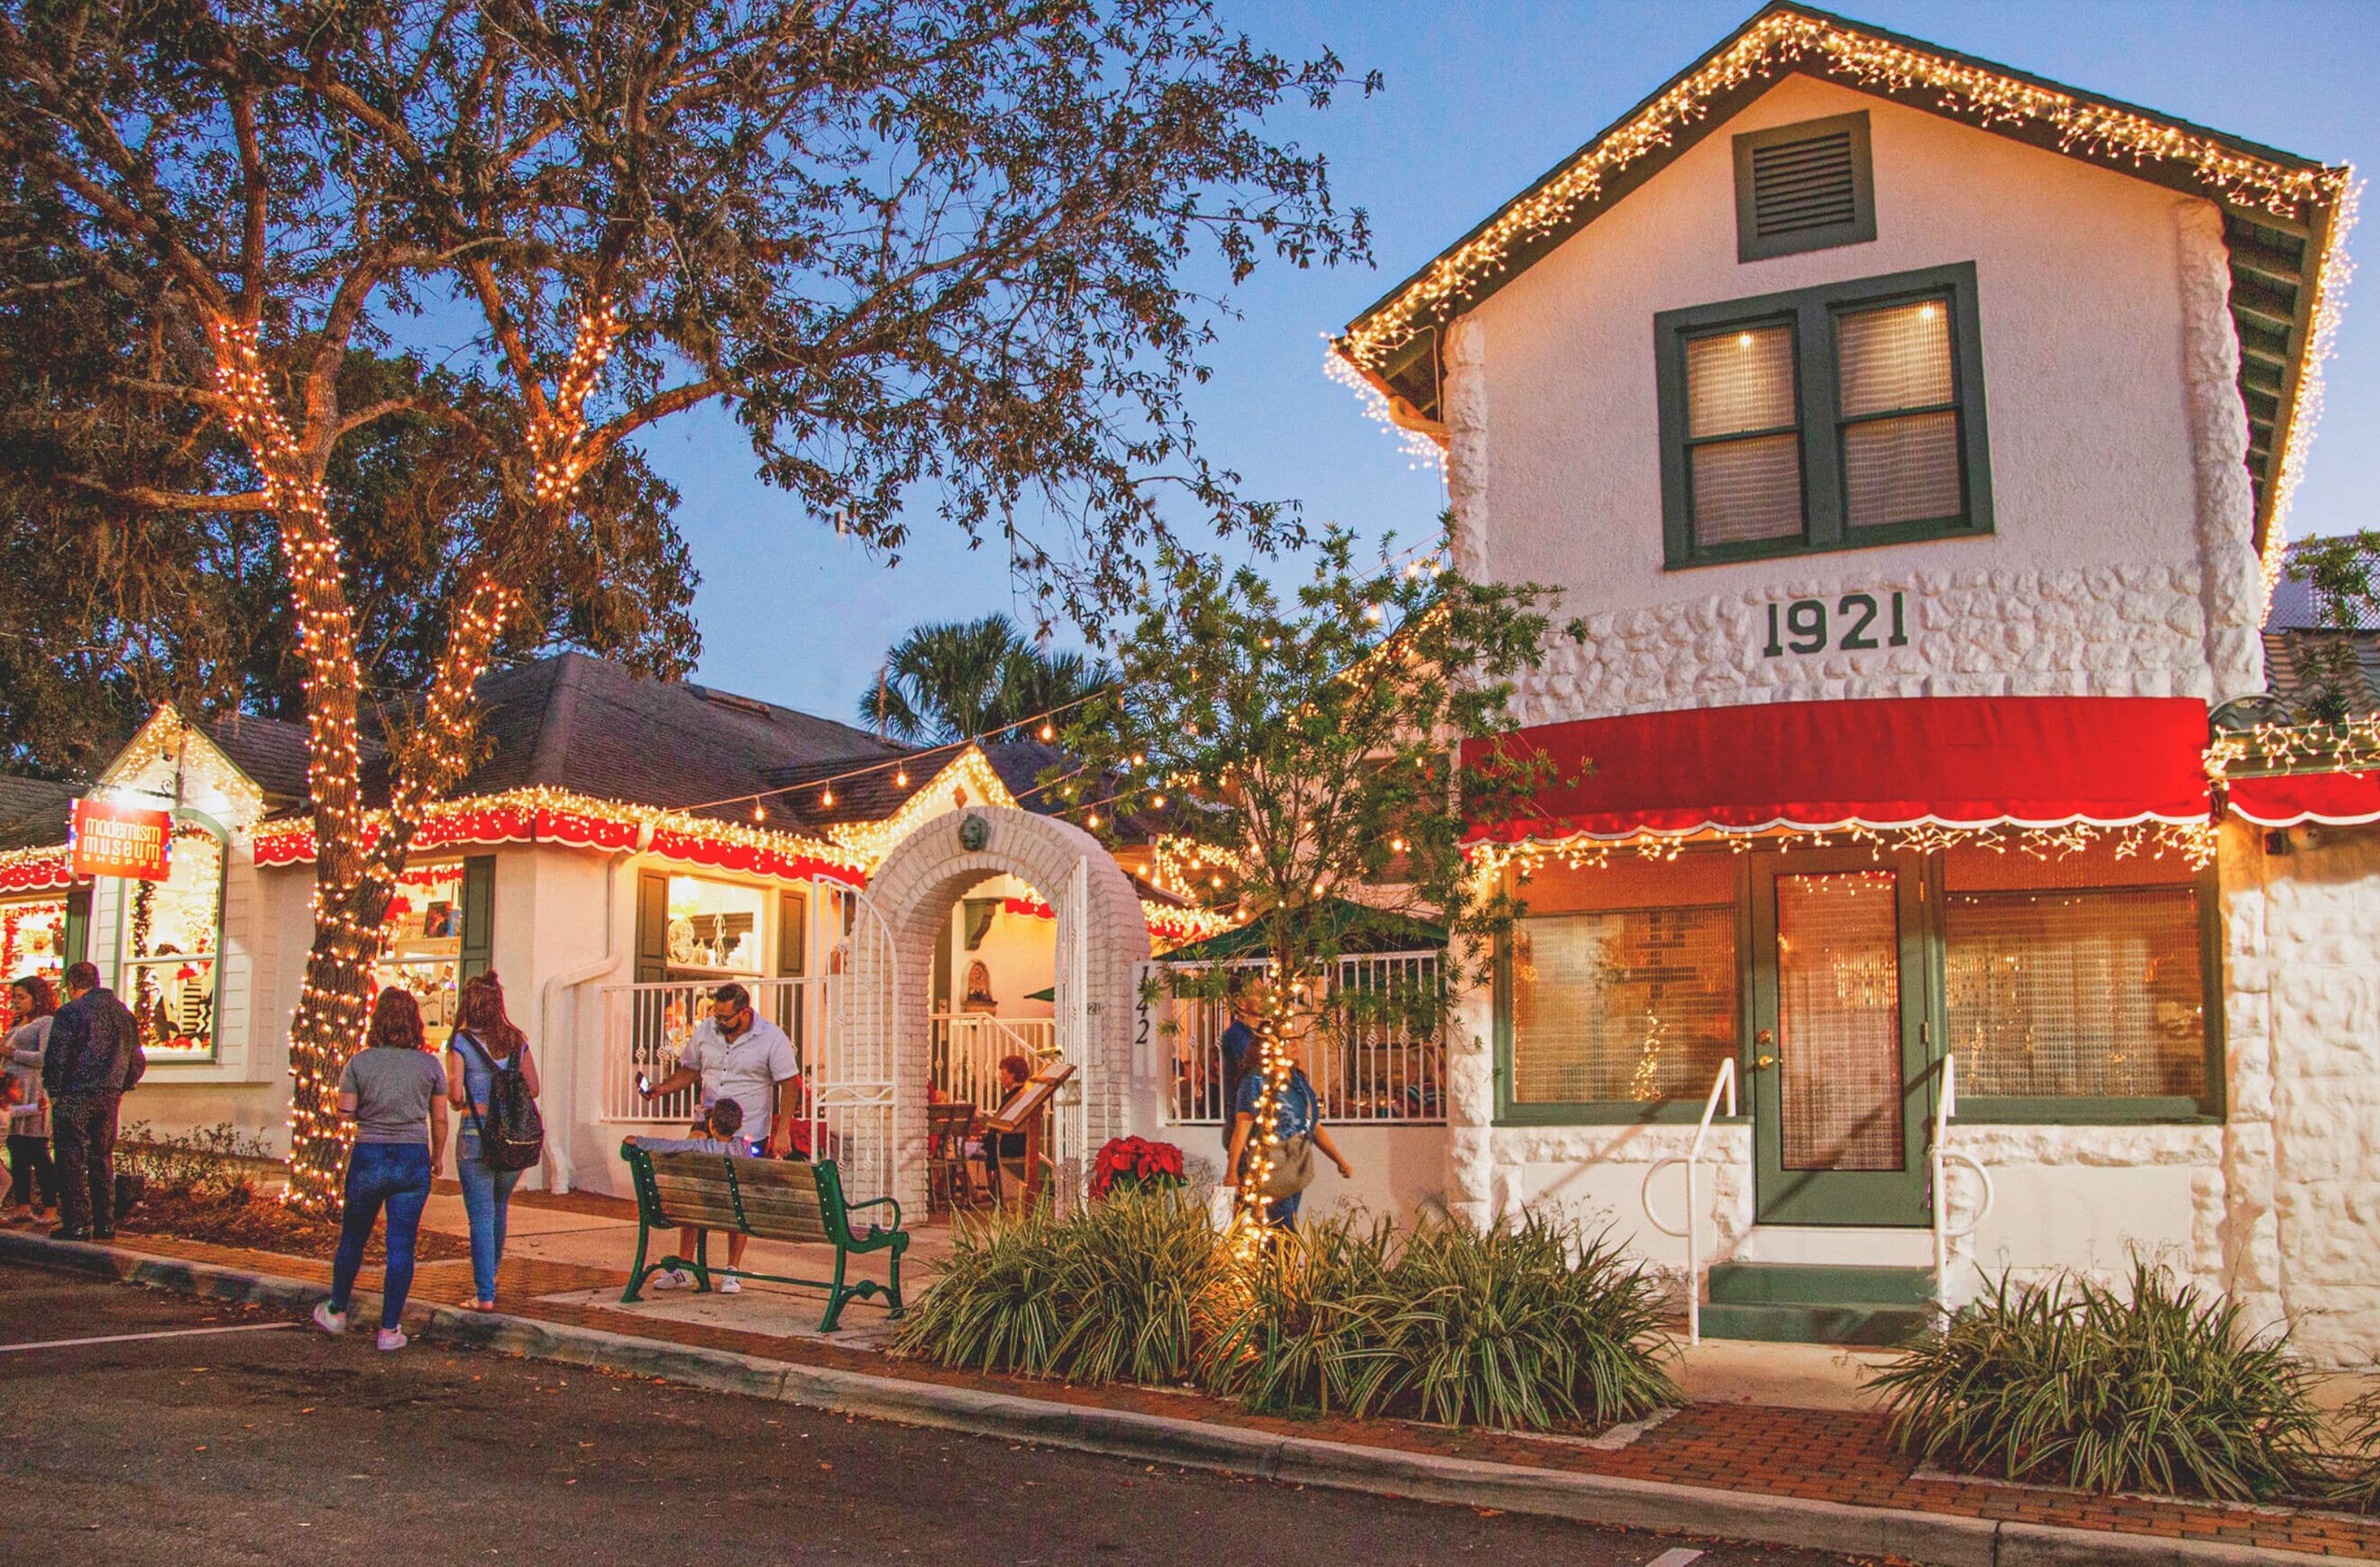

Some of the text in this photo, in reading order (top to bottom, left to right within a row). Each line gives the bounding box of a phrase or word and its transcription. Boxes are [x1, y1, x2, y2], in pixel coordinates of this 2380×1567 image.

[1763, 591, 1909, 658] 1921
[84, 815, 161, 844] modernism
[82, 852, 160, 870] SHOPPE
[83, 835, 160, 861] museum
